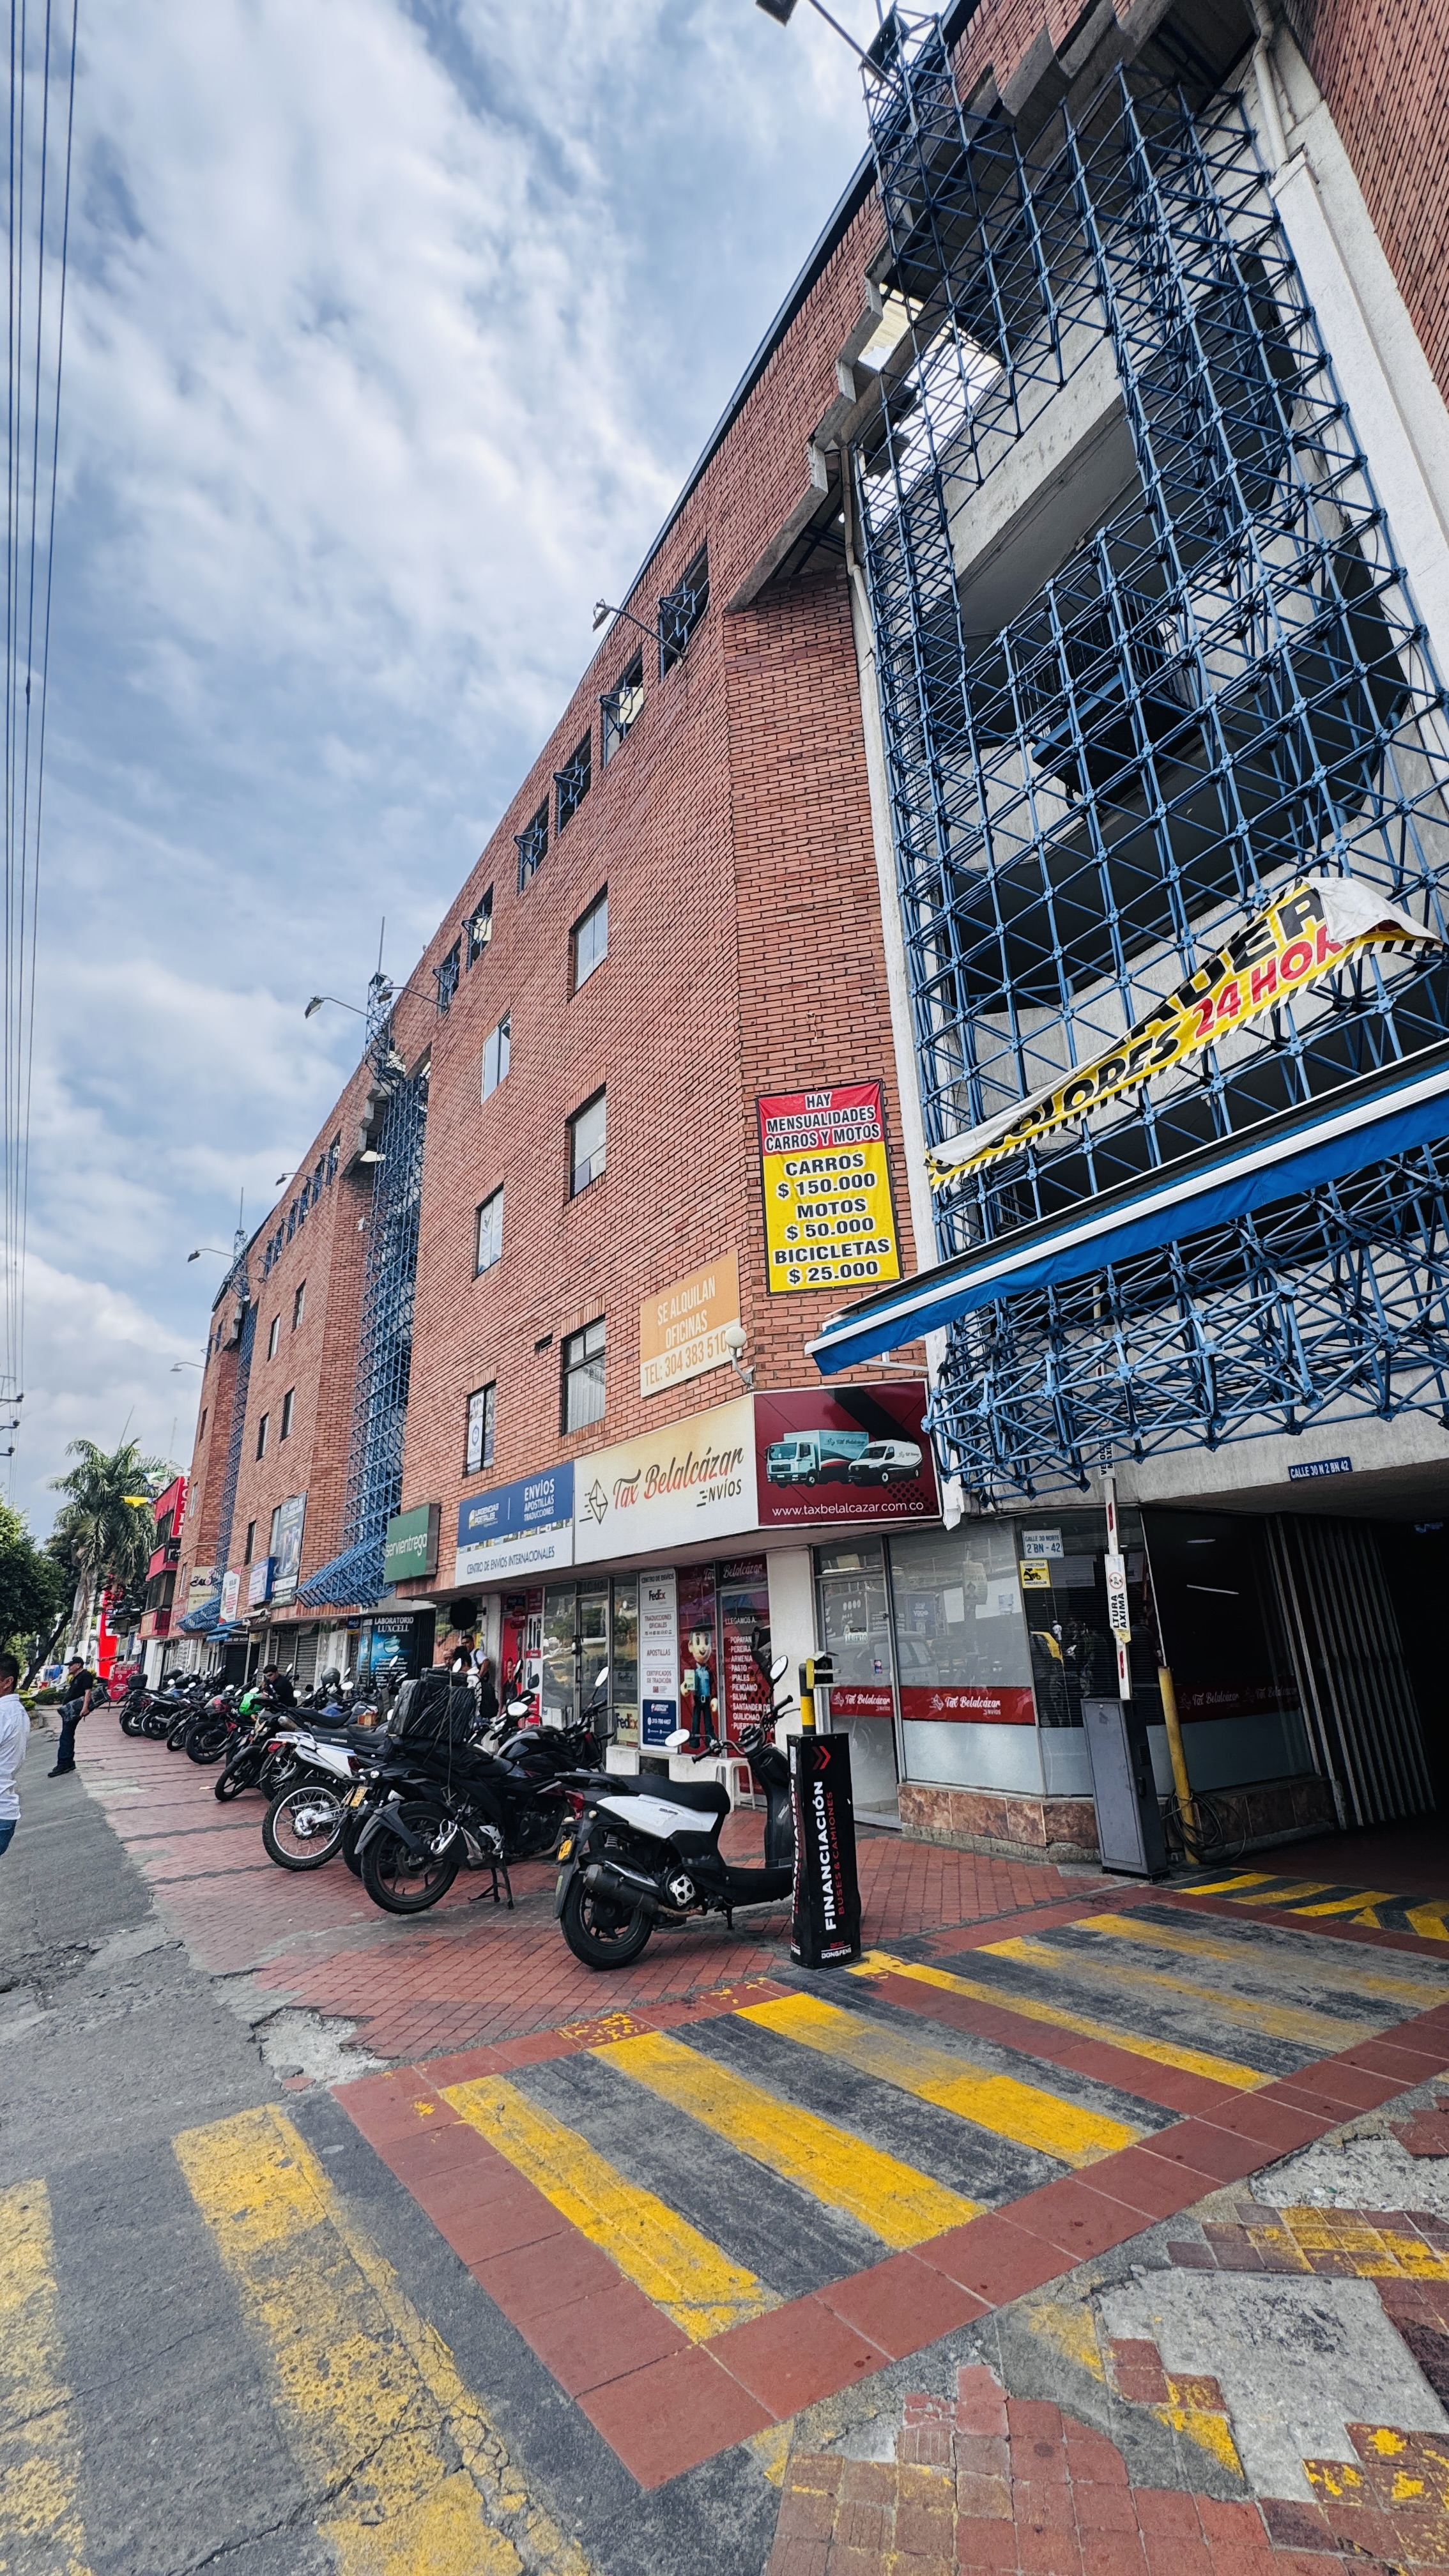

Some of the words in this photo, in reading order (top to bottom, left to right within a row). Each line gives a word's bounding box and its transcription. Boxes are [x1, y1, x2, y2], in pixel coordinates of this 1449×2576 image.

[1193, 982, 1241, 1038] 24
[807, 1094, 831, 1108] HAY
[767, 1107, 875, 1132] MENSUALIDADES
[766, 1133, 816, 1151] CARROS
[821, 1131, 829, 1144] Y
[834, 1124, 880, 1143] MOTOS
[786, 1154, 863, 1176] CARROS
[778, 1183, 789, 1198] $
[796, 1174, 875, 1195] 150.000
[797, 1199, 866, 1218] MOTOS
[787, 1225, 798, 1240] $
[806, 1218, 873, 1238] 50.000
[775, 1239, 889, 1264] BICICLETAS
[789, 1268, 800, 1284] $
[808, 1262, 878, 1281] 25.000
[657, 1301, 668, 1326] SE
[670, 1275, 716, 1319] ALQUILAN
[665, 1309, 707, 1349] OFICINAS
[645, 1363, 663, 1386] TEL:
[665, 1350, 683, 1377] 304
[686, 1340, 703, 1368] 383
[613, 1469, 641, 1510] Tax
[644, 1446, 744, 1499] Belalcázar
[1291, 1466, 1310, 1478] CALLE
[1310, 1465, 1318, 1476] 30
[1325, 1464, 1330, 1473] 2
[1341, 1460, 1349, 1471] 42
[525, 1478, 555, 1501] ENVÍOS
[524, 1494, 554, 1512] APOSTILLAS
[772, 1502, 924, 1516] www.taxbelalcazar.com.co
[524, 1506, 554, 1521] TRADUCCIONES
[386, 1533, 427, 1556] servientrega
[1027, 1544, 1032, 1554] 2
[1034, 1544, 1044, 1553] BN
[1051, 1542, 1061, 1552] 42
[467, 1562, 483, 1574] CENTRO
[484, 1560, 489, 1571] DE
[509, 1545, 555, 1567] INTERNACIONALES
[723, 1563, 762, 1579] Belalcázar
[648, 1589, 666, 1601] FedEx
[374, 1616, 414, 1625] LABORATORIO
[378, 1624, 409, 1632] LUXCELL
[725, 1616, 751, 1625] LLEGAMOS
[733, 1703, 762, 1711] SANTANDER
[845, 1694, 856, 1704] Tax
[857, 1694, 890, 1705] Belalcázar
[945, 1698, 958, 1708] Tax
[960, 1696, 1001, 1708] Belalcázar
[1192, 1693, 1204, 1706] Tax
[1206, 1691, 1239, 1704] Belalcázar
[616, 1713, 638, 1729] FedEx
[827, 1792, 839, 1859] CAMIONES
[813, 1781, 836, 1930] FINANCIACIÓN
[835, 1873, 845, 1915] BUSES
[821, 1947, 851, 1959] DONGFENG
